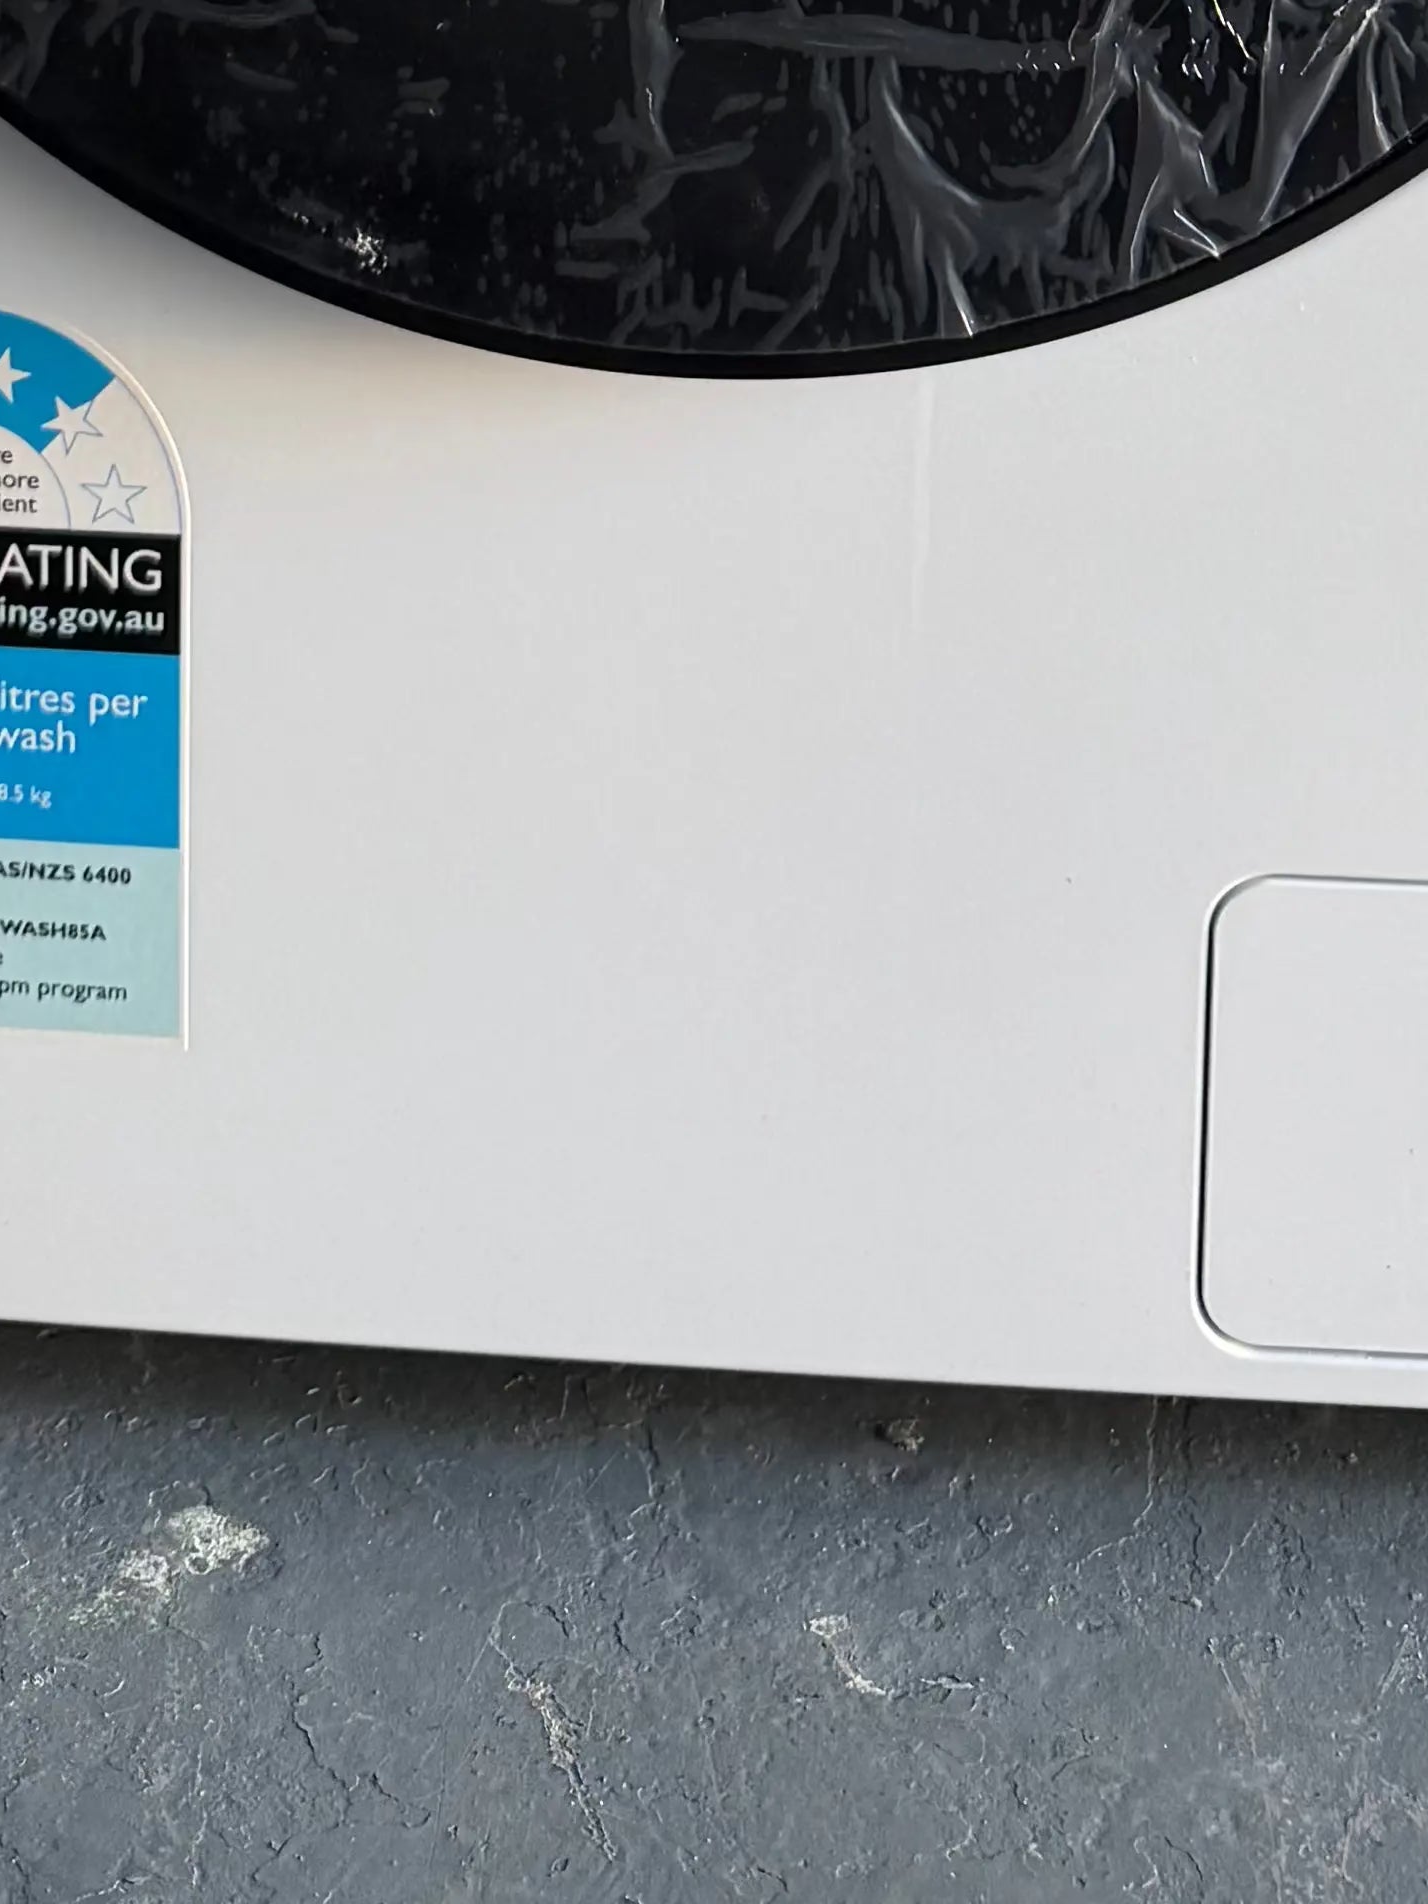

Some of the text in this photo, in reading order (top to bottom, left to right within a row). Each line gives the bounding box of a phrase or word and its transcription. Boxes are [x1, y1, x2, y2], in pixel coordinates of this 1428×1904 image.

[88, 691, 148, 726] per
[30, 785, 52, 809] kg
[82, 865, 132, 885] 6400
[37, 981, 128, 1003] program
